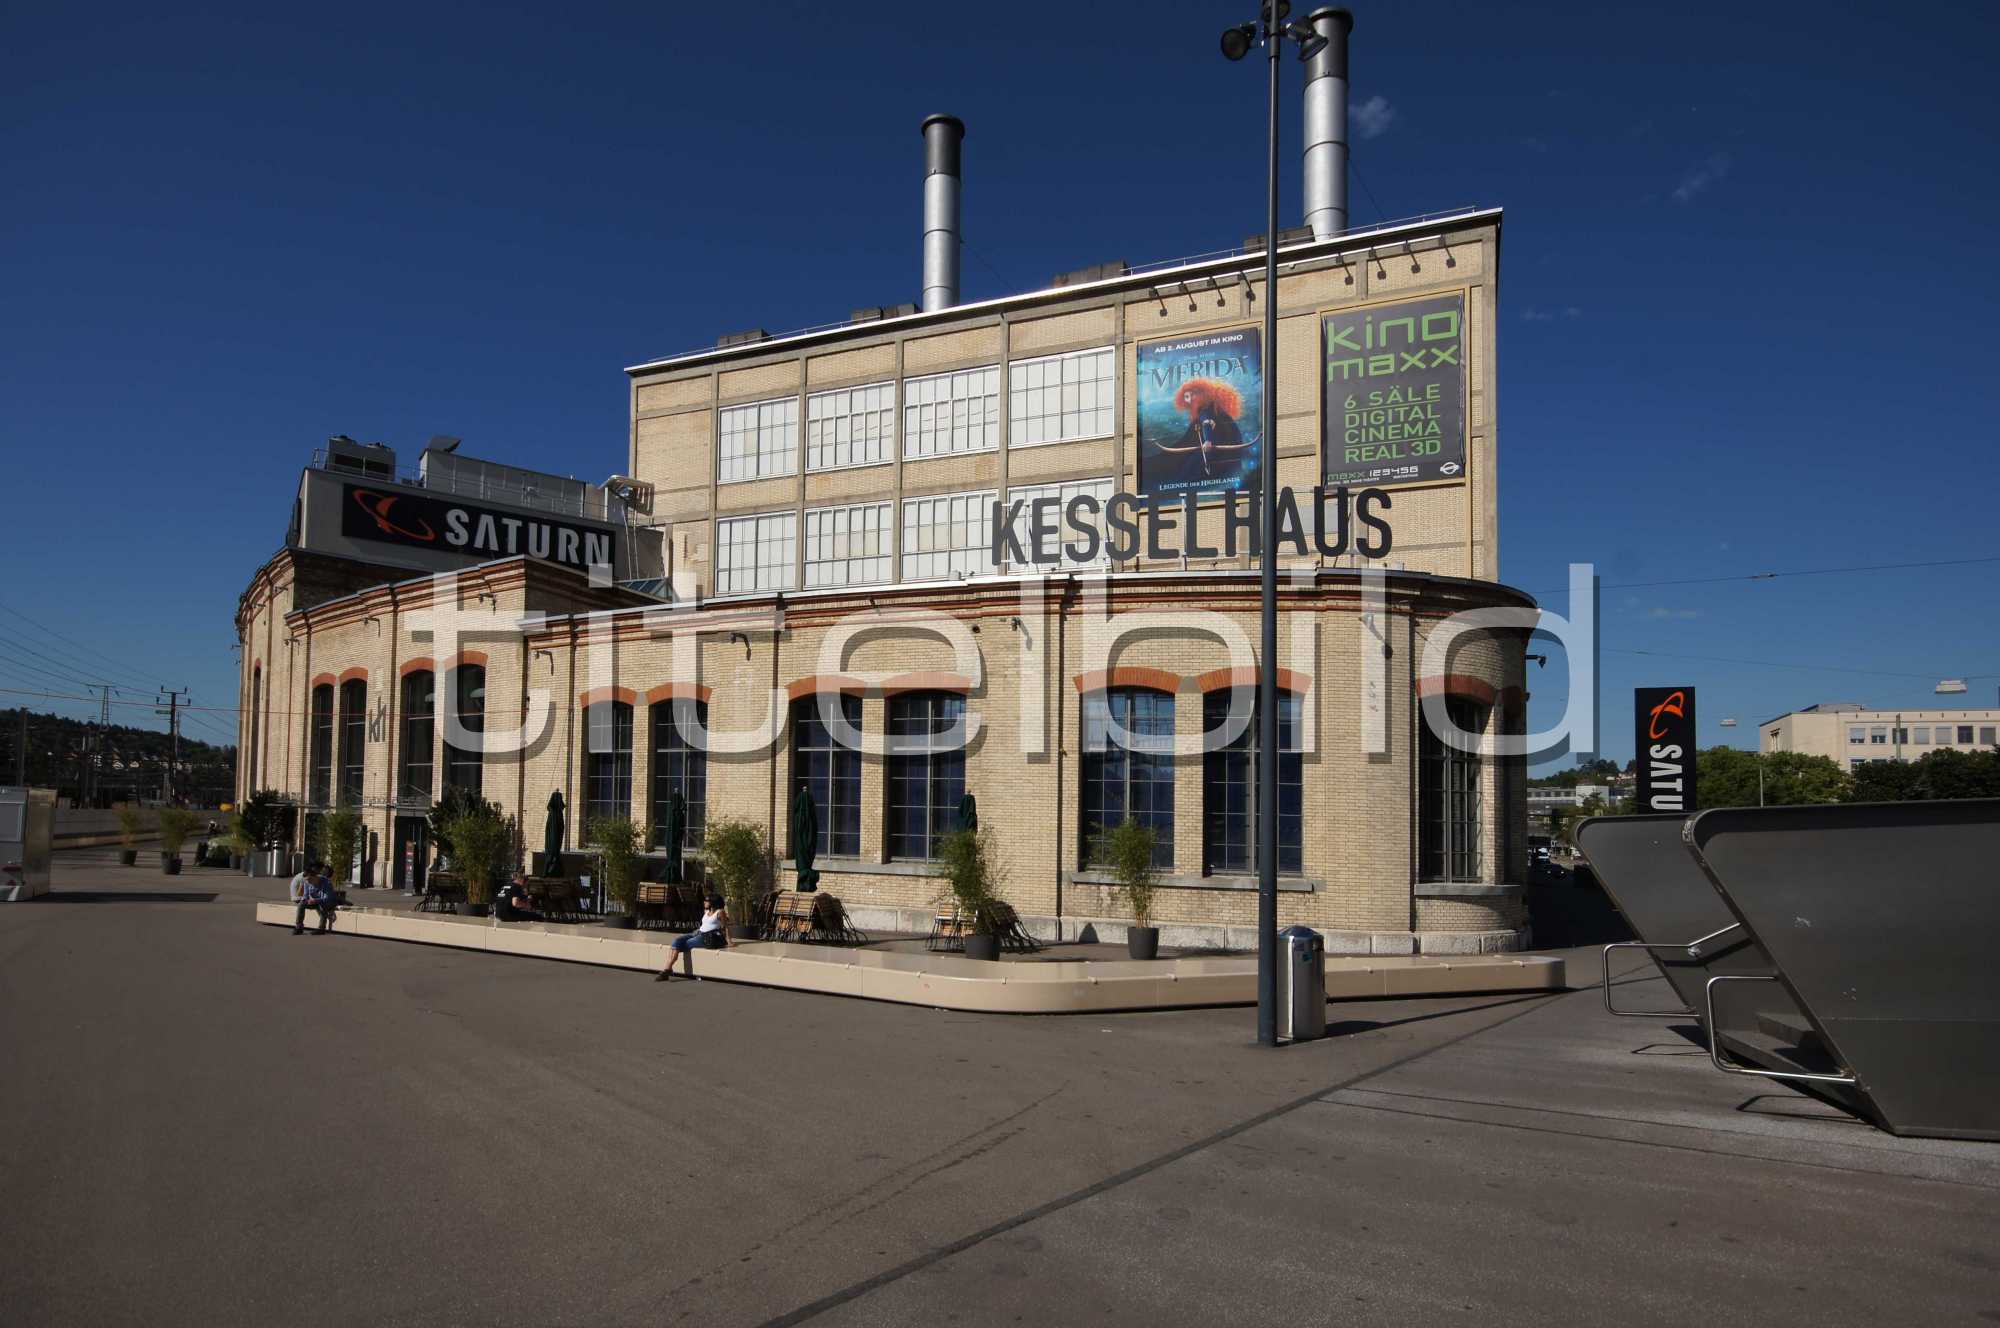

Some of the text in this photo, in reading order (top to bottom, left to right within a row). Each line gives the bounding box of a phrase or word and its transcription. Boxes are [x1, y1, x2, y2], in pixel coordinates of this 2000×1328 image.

[1154, 345, 1166, 353] AB
[1176, 339, 1210, 350] AUGUST
[1210, 337, 1221, 345] IM
[1222, 334, 1243, 343] KINO
[1327, 311, 1458, 354] kino
[1151, 355, 1249, 388] MERIDA
[1327, 345, 1458, 384] maxx
[1344, 384, 1440, 409] 6 SÄLE
[1345, 404, 1440, 429] DIGITAL
[1345, 420, 1441, 444] CINEMA
[1345, 440, 1441, 464] REAL 3D
[1160, 482, 1189, 491] LEGENDE
[1200, 476, 1241, 486] HIGHLANDS
[1327, 471, 1366, 481] maxx
[445, 508, 610, 568] SATURN
[991, 486, 1392, 565] KESSELHAUS
